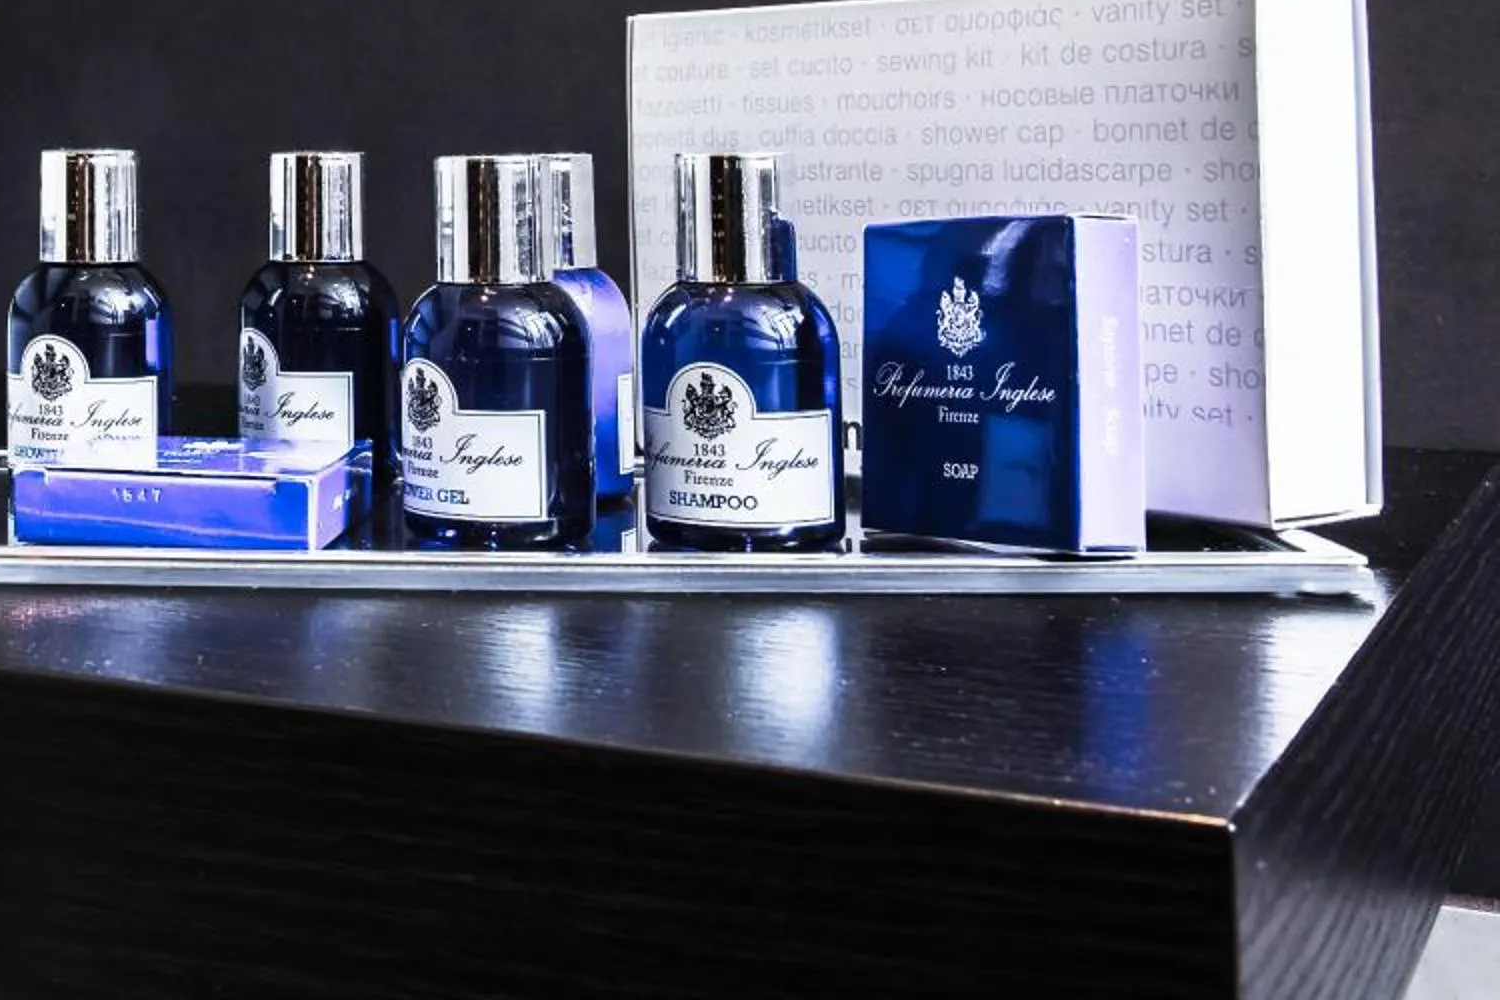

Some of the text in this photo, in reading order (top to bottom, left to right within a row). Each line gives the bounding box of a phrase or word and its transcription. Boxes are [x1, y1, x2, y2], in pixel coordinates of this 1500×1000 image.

[744, 16, 871, 42] kosmetikset
[749, 57, 779, 78] set
[786, 54, 853, 77] cucito
[876, 50, 957, 76] sewing
[965, 47, 994, 70] kit
[1020, 44, 1050, 67] kit
[1059, 39, 1092, 66] de
[1101, 36, 1208, 64] costura
[835, 87, 956, 112] mouchoirs
[980, 79, 1240, 108] носовые платочки
[822, 123, 898, 147] doccia
[920, 121, 1010, 146] shower
[1016, 121, 1064, 150] cap
[1092, 117, 1189, 143] bonnet
[1201, 116, 1236, 142] de
[794, 160, 884, 182] ustrante
[905, 160, 994, 187] spugna
[1003, 157, 1173, 187] lucidascarpe
[1202, 158, 1261, 183] sho
[1186, 196, 1231, 223] set
[1141, 239, 1213, 265] stura
[1140, 283, 1247, 308] аточки
[1206, 319, 1242, 348] de
[946, 364, 974, 381] 1843
[1208, 361, 1262, 390] sho
[873, 361, 1057, 412] Profumeria Inglese
[38, 403, 64, 416] 1843
[70, 399, 143, 433] Inglese
[263, 391, 336, 427] Inglese
[938, 405, 980, 424] Firenze
[439, 433, 525, 475] Inglese
[693, 443, 726, 457] 1843
[735, 437, 820, 480] Inglese
[684, 469, 734, 487] Firenze
[943, 463, 979, 480] SOAP
[437, 488, 470, 505] GEL
[668, 490, 759, 511] SHAMPOO
